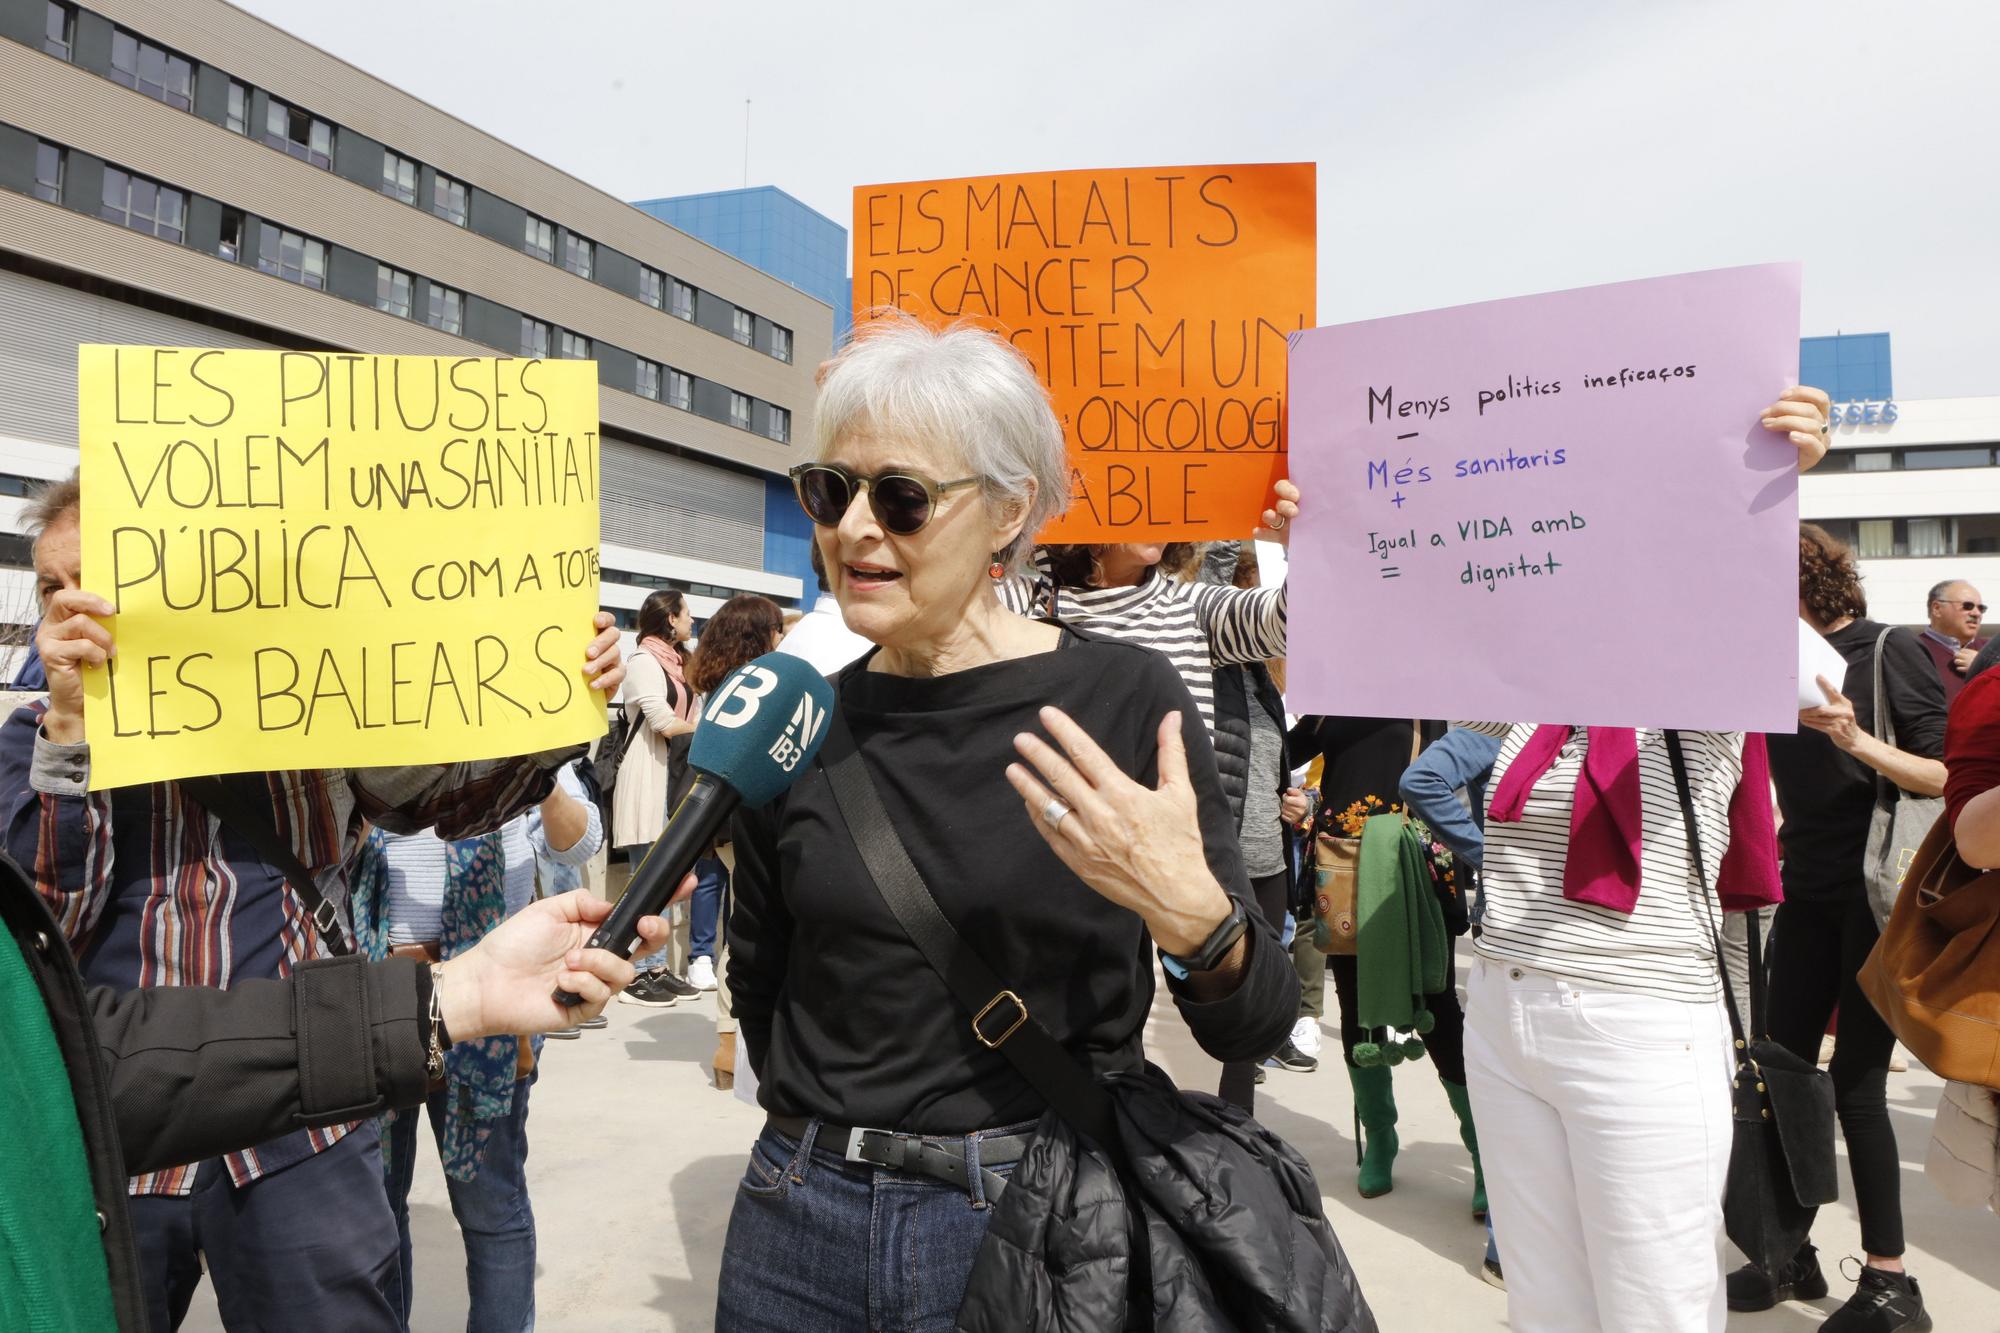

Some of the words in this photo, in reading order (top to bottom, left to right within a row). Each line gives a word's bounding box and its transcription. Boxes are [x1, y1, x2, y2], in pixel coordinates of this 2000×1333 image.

[868, 188, 945, 256] ELS
[965, 175, 1239, 251] MALALTS
[869, 268, 917, 320] DE
[929, 255, 1153, 316] CÀNCER
[114, 348, 234, 427] LES
[280, 351, 548, 432] PITIUSES
[1367, 385, 1451, 424] Menys
[1583, 363, 1697, 389] ineficaços
[1829, 403, 1898, 427] SSES
[112, 434, 330, 509] VOLEM
[349, 460, 433, 510] UNA
[434, 431, 597, 511] SANITAT
[1061, 464, 1209, 527] ABLE
[1367, 457, 1432, 490] Més
[1454, 447, 1567, 478] sanitaris
[112, 519, 392, 614] PÚBLICA
[411, 556, 503, 602] COM
[514, 553, 542, 593] A
[1367, 529, 1416, 560] Igual
[1430, 533, 1446, 548] a
[1457, 515, 1513, 542] VIDA
[1531, 510, 1587, 534] amb
[1460, 551, 1563, 593] dignitat
[107, 652, 223, 739] LES
[254, 624, 573, 737] BALEARS
[768, 733, 802, 772] IB3
